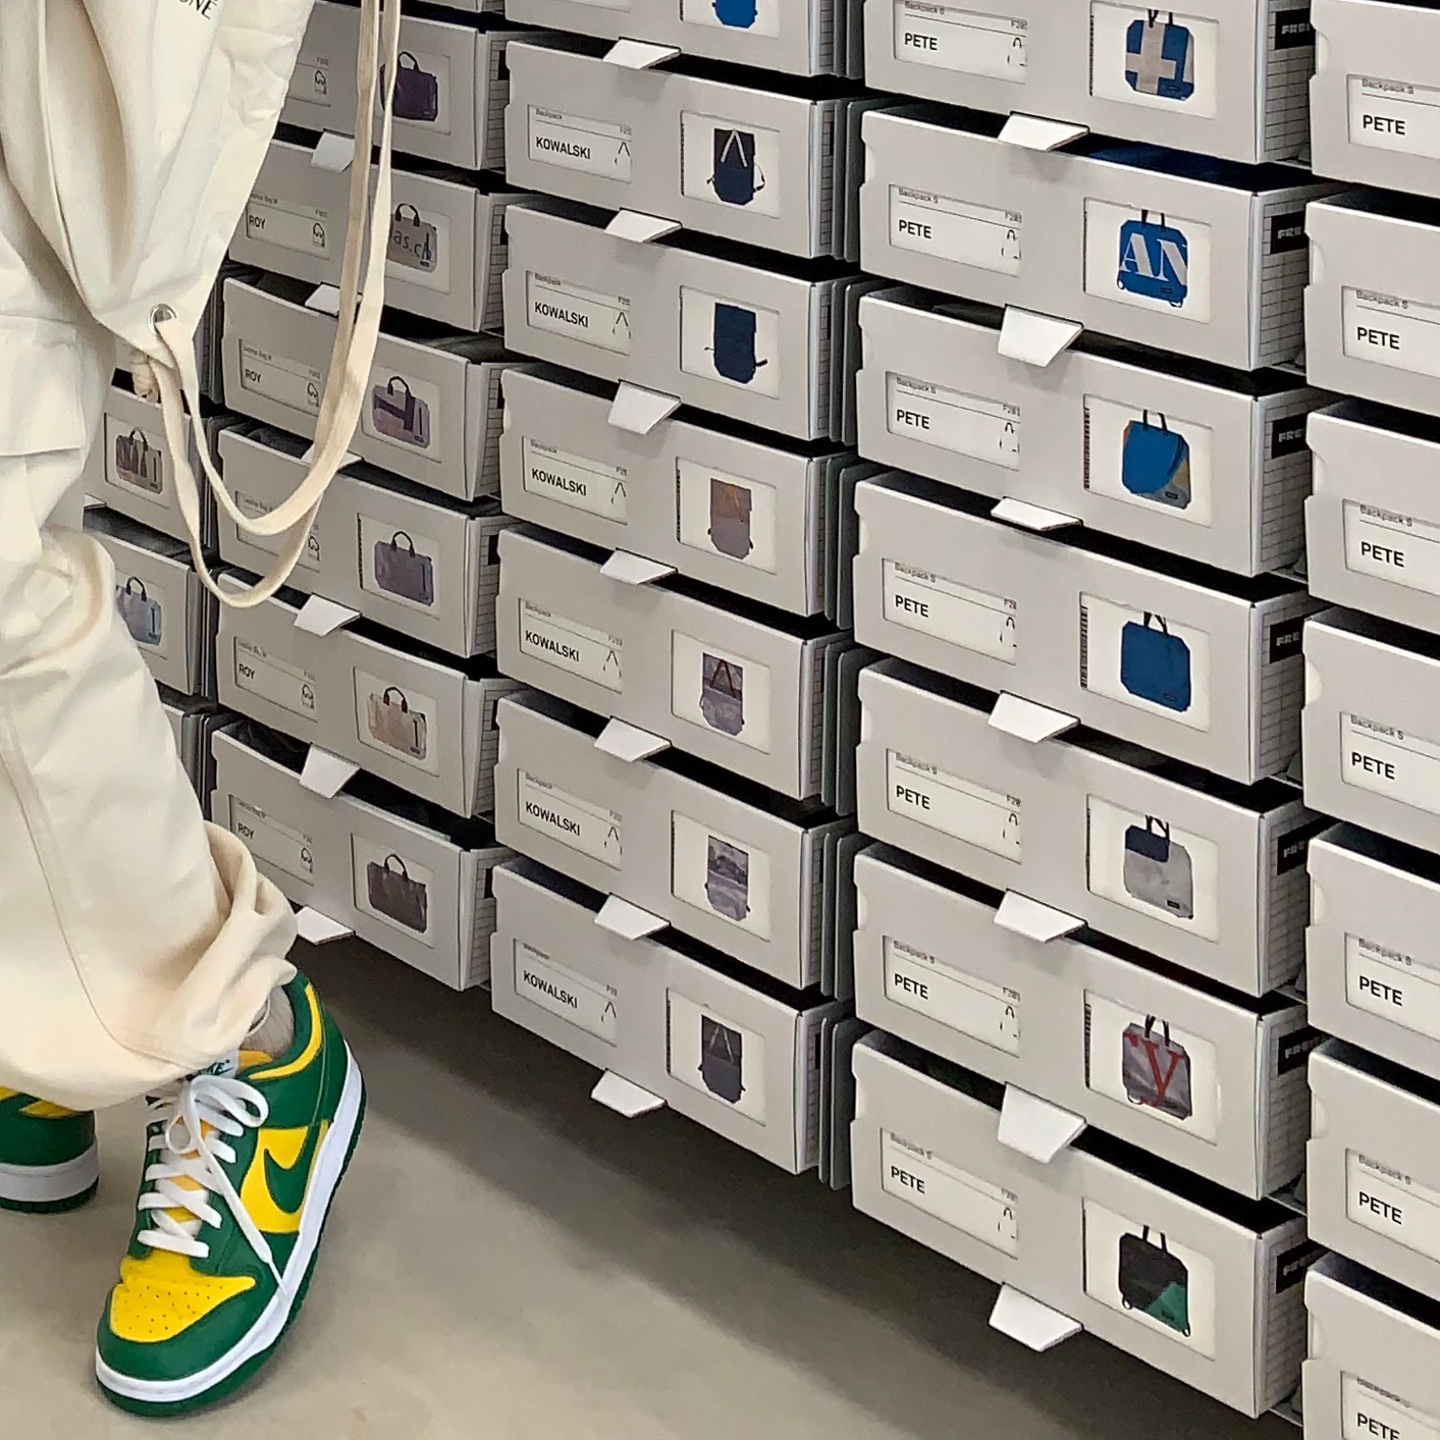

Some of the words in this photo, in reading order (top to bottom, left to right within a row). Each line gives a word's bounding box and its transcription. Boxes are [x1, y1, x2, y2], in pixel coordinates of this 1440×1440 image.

[904, 34, 937, 50] PETE
[1362, 79, 1406, 94] Backpack
[1363, 115, 1405, 135] PETE
[536, 137, 590, 159] KOWALSKI
[249, 215, 266, 229] ROY
[899, 220, 931, 239] PETE
[1356, 290, 1399, 308] Backpack
[535, 302, 588, 327] KOWALSKI
[1357, 327, 1399, 350] PETE
[245, 369, 261, 383] ROY
[897, 409, 930, 429] PETE
[532, 468, 586, 495] KOWALSKI
[1360, 505, 1404, 525] Backpack
[1362, 542, 1404, 567] PETE
[895, 595, 928, 617] PETE
[526, 630, 579, 661] KOWALSKI
[239, 663, 255, 679] ROY
[1350, 715, 1394, 737] Backpack
[1352, 752, 1395, 780] PETE
[896, 785, 930, 810] PETE
[526, 802, 580, 836] KOWALSKI
[238, 823, 254, 839] ROY
[1359, 938, 1401, 962] Backpack
[524, 970, 577, 1008] KOWALSKI
[895, 973, 928, 999] PETE
[1359, 975, 1402, 1006] PETE
[1359, 1154, 1402, 1182] Backpack
[891, 1166, 925, 1194] PETE
[1359, 1191, 1402, 1225] PETE
[1356, 1412, 1401, 1440] PETE
